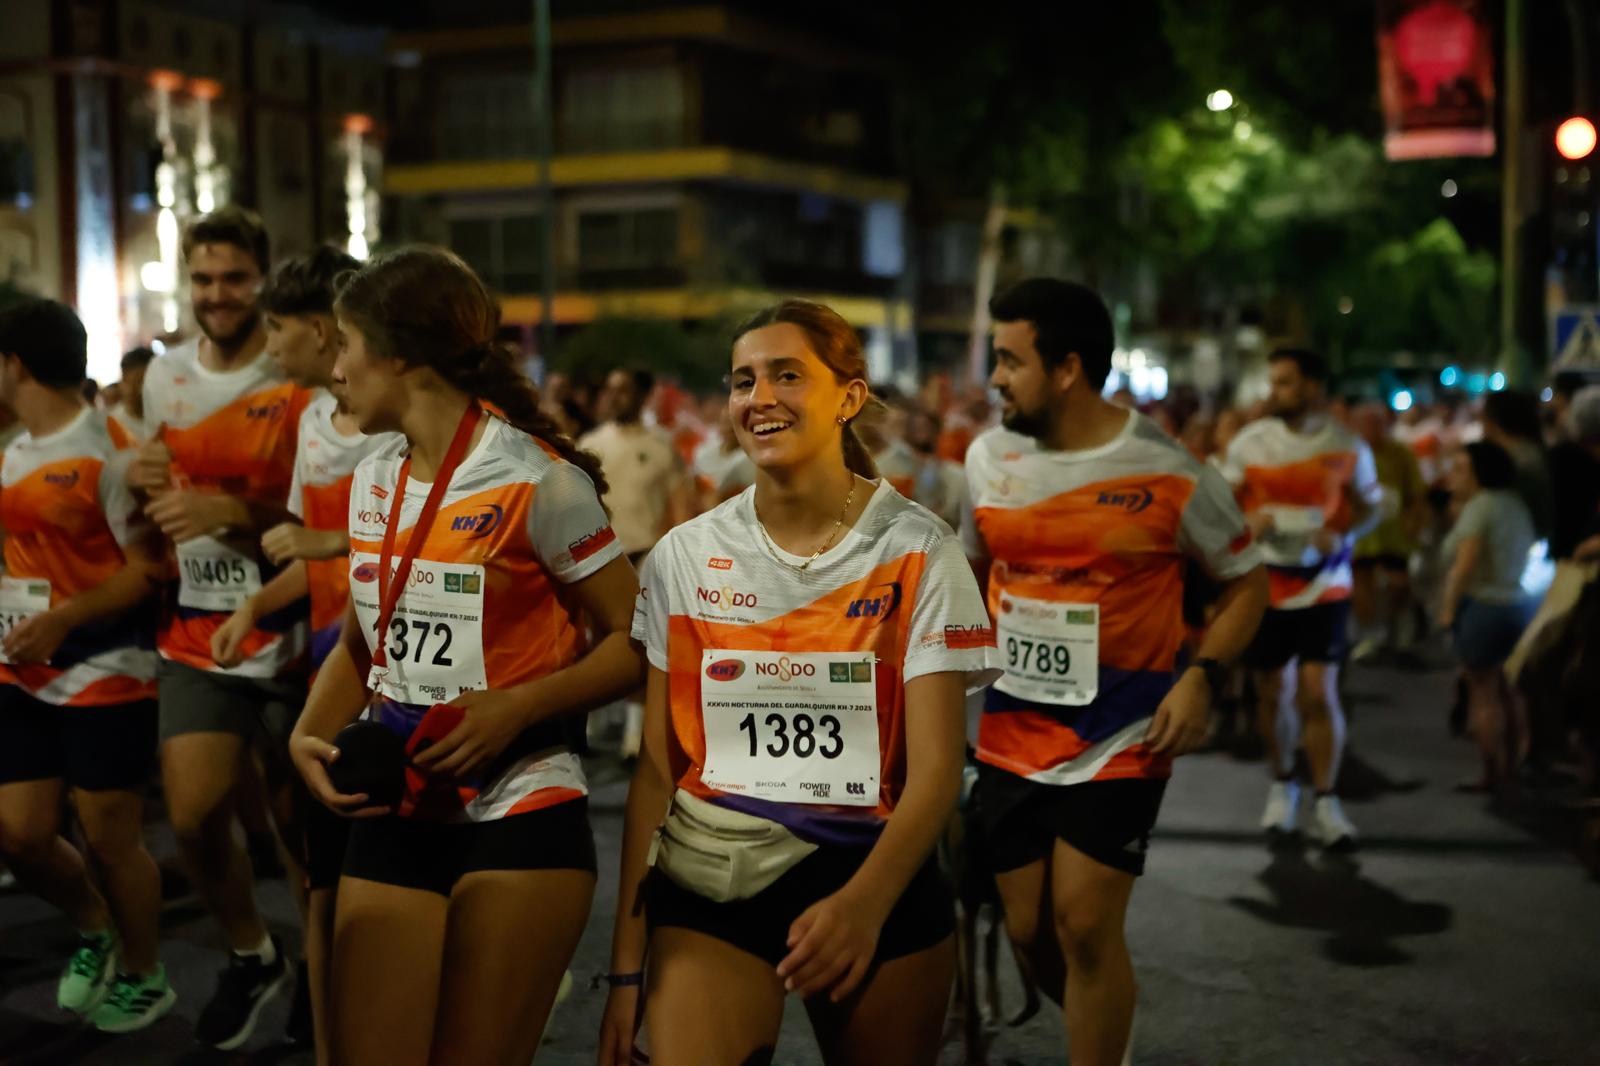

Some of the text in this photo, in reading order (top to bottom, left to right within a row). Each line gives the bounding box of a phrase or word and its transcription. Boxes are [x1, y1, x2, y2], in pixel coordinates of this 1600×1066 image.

[184, 558, 246, 585] 10405
[373, 616, 453, 667] 372
[1006, 636, 1071, 675] 9789
[418, 684, 447, 693] POWER
[784, 702, 836, 711] GUADALQUIVIR
[854, 704, 873, 712] 2025
[739, 712, 844, 760] 1383
[799, 782, 831, 791] POWER
[812, 789, 831, 799] ADE
